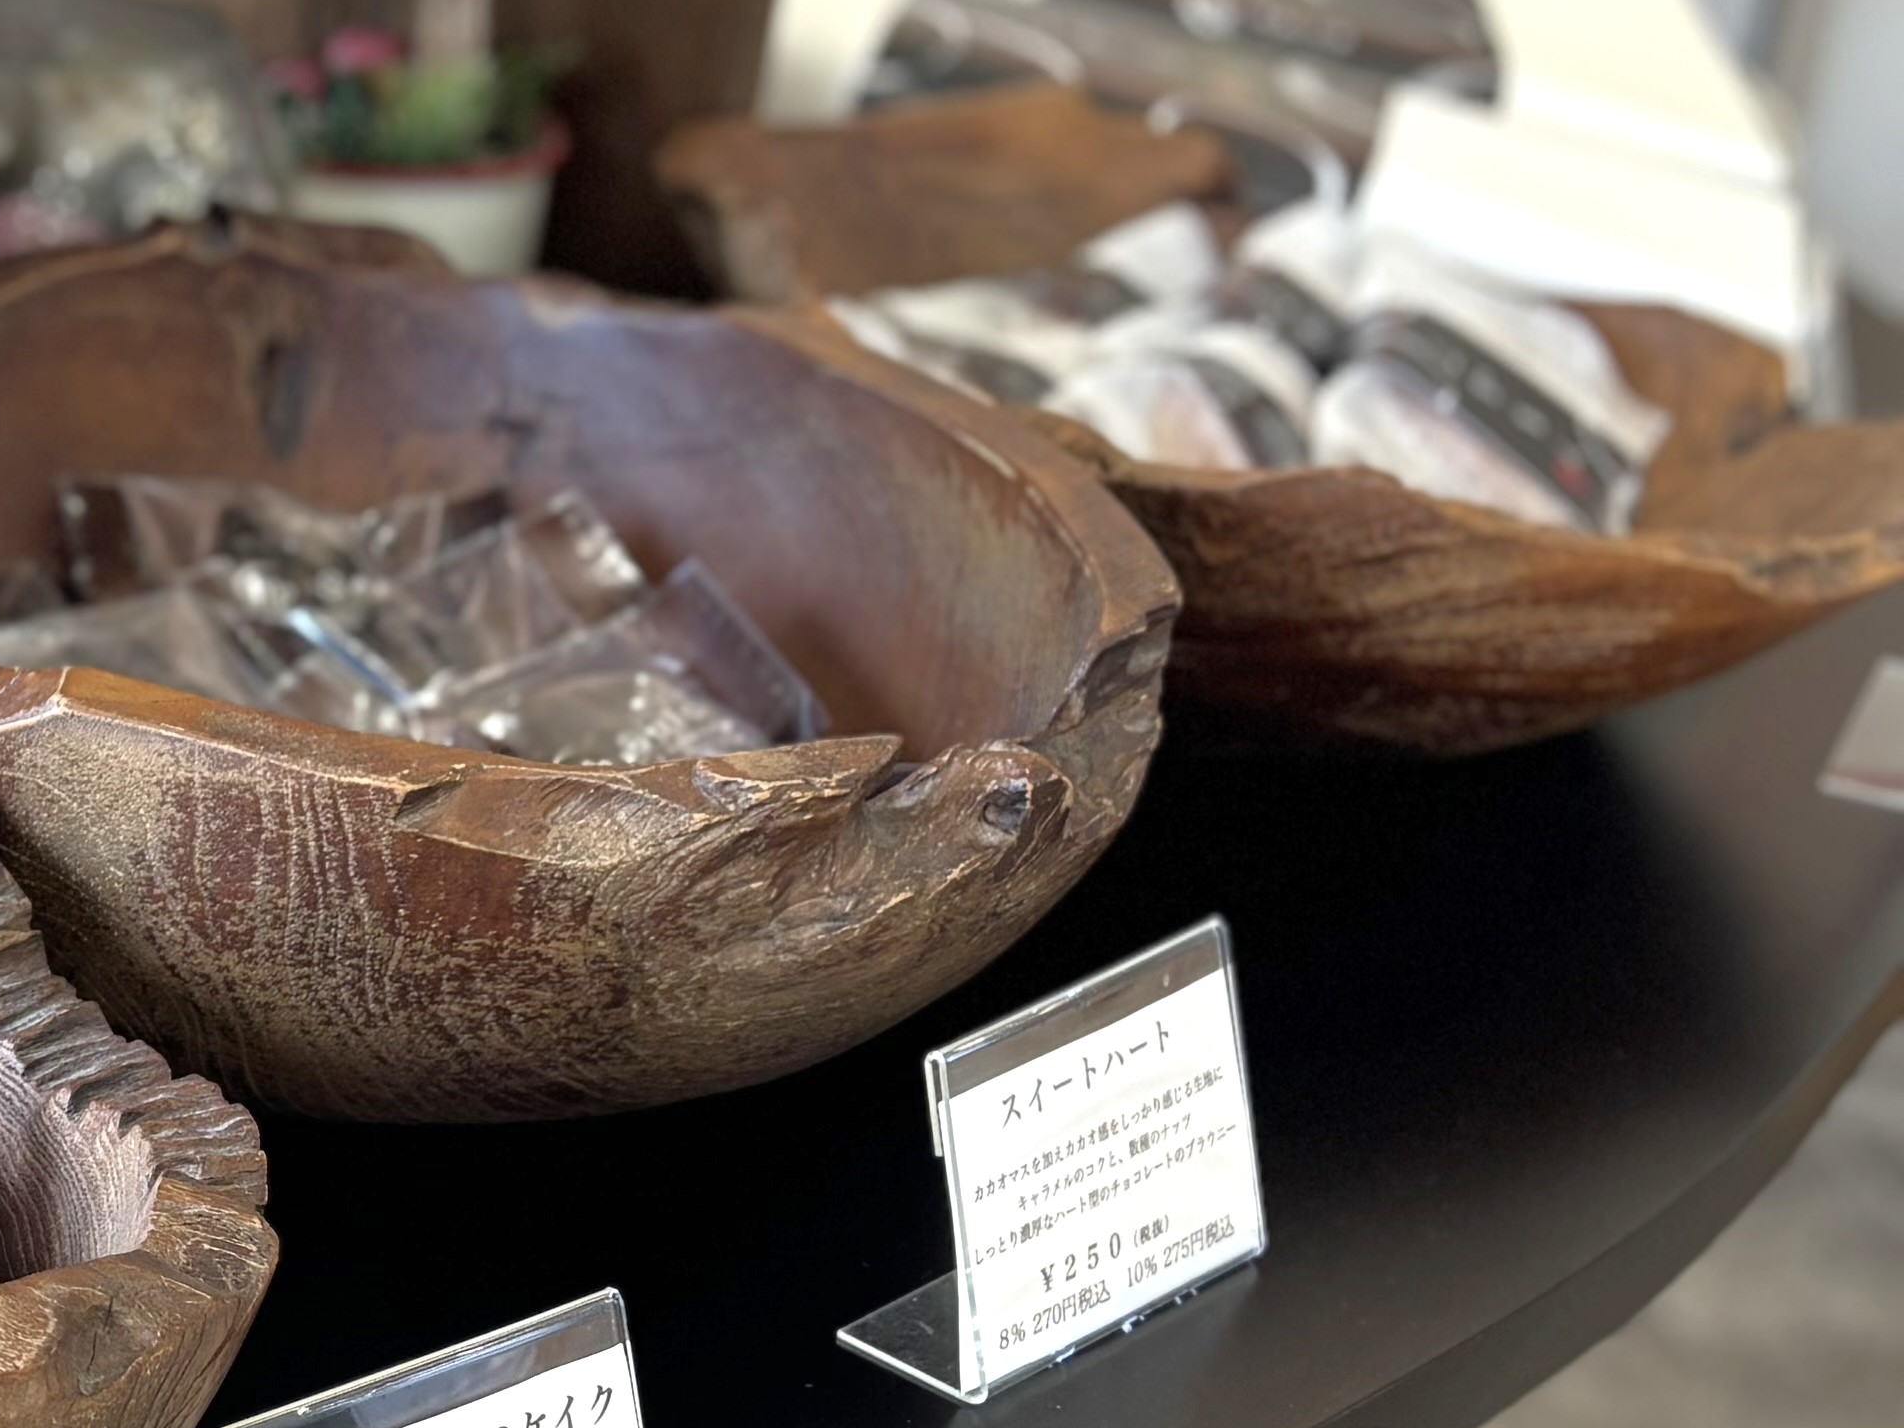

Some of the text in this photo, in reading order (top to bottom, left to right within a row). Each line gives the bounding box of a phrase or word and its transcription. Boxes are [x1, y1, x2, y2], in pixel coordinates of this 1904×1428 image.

[1001, 1020, 1169, 1127] スイートハート
[974, 1066, 1223, 1203] カカオマスを加えカカオ感をしっかり感じる生地に
[999, 1214, 1235, 1349] 8% 270円税込 10% 275円税込
[1040, 1232, 1121, 1292] ¥250
